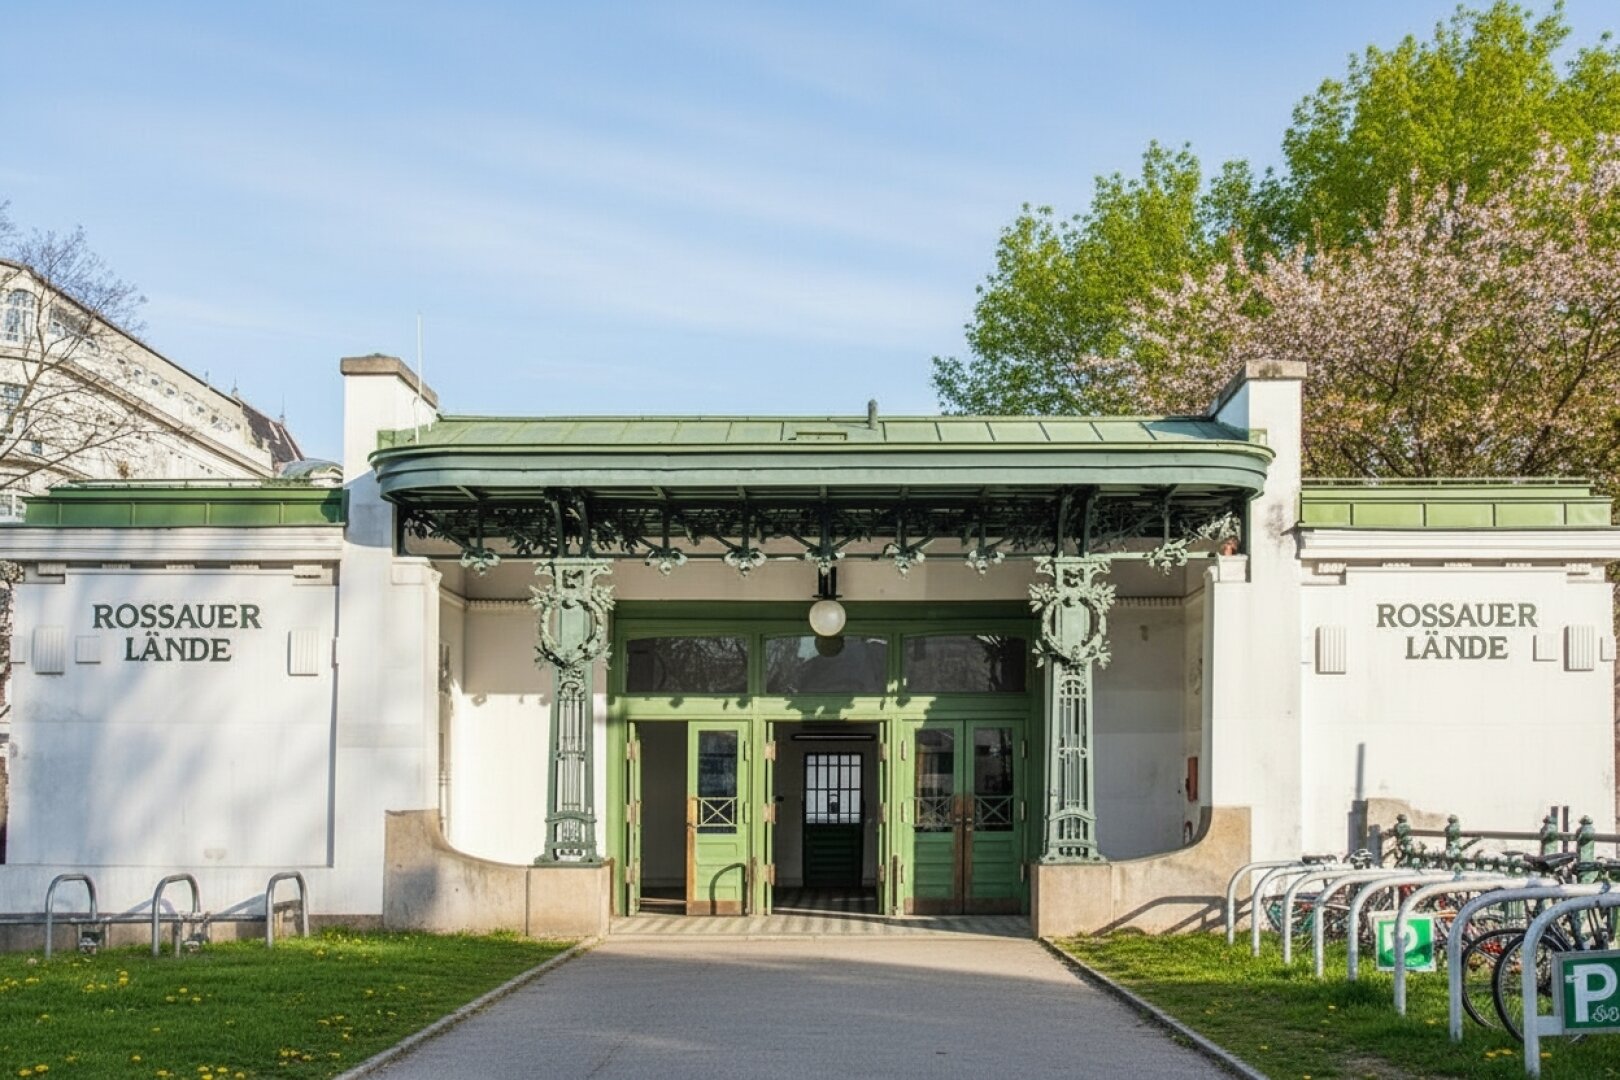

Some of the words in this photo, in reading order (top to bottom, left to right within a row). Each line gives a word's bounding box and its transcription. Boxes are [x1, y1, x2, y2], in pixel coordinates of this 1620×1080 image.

[92, 603, 262, 629] ROSSAUER
[1377, 603, 1538, 628] ROSSAUER
[124, 631, 232, 662] LÄNDE
[1405, 630, 1509, 660] LÄNDE
[1573, 963, 1618, 1023] P
